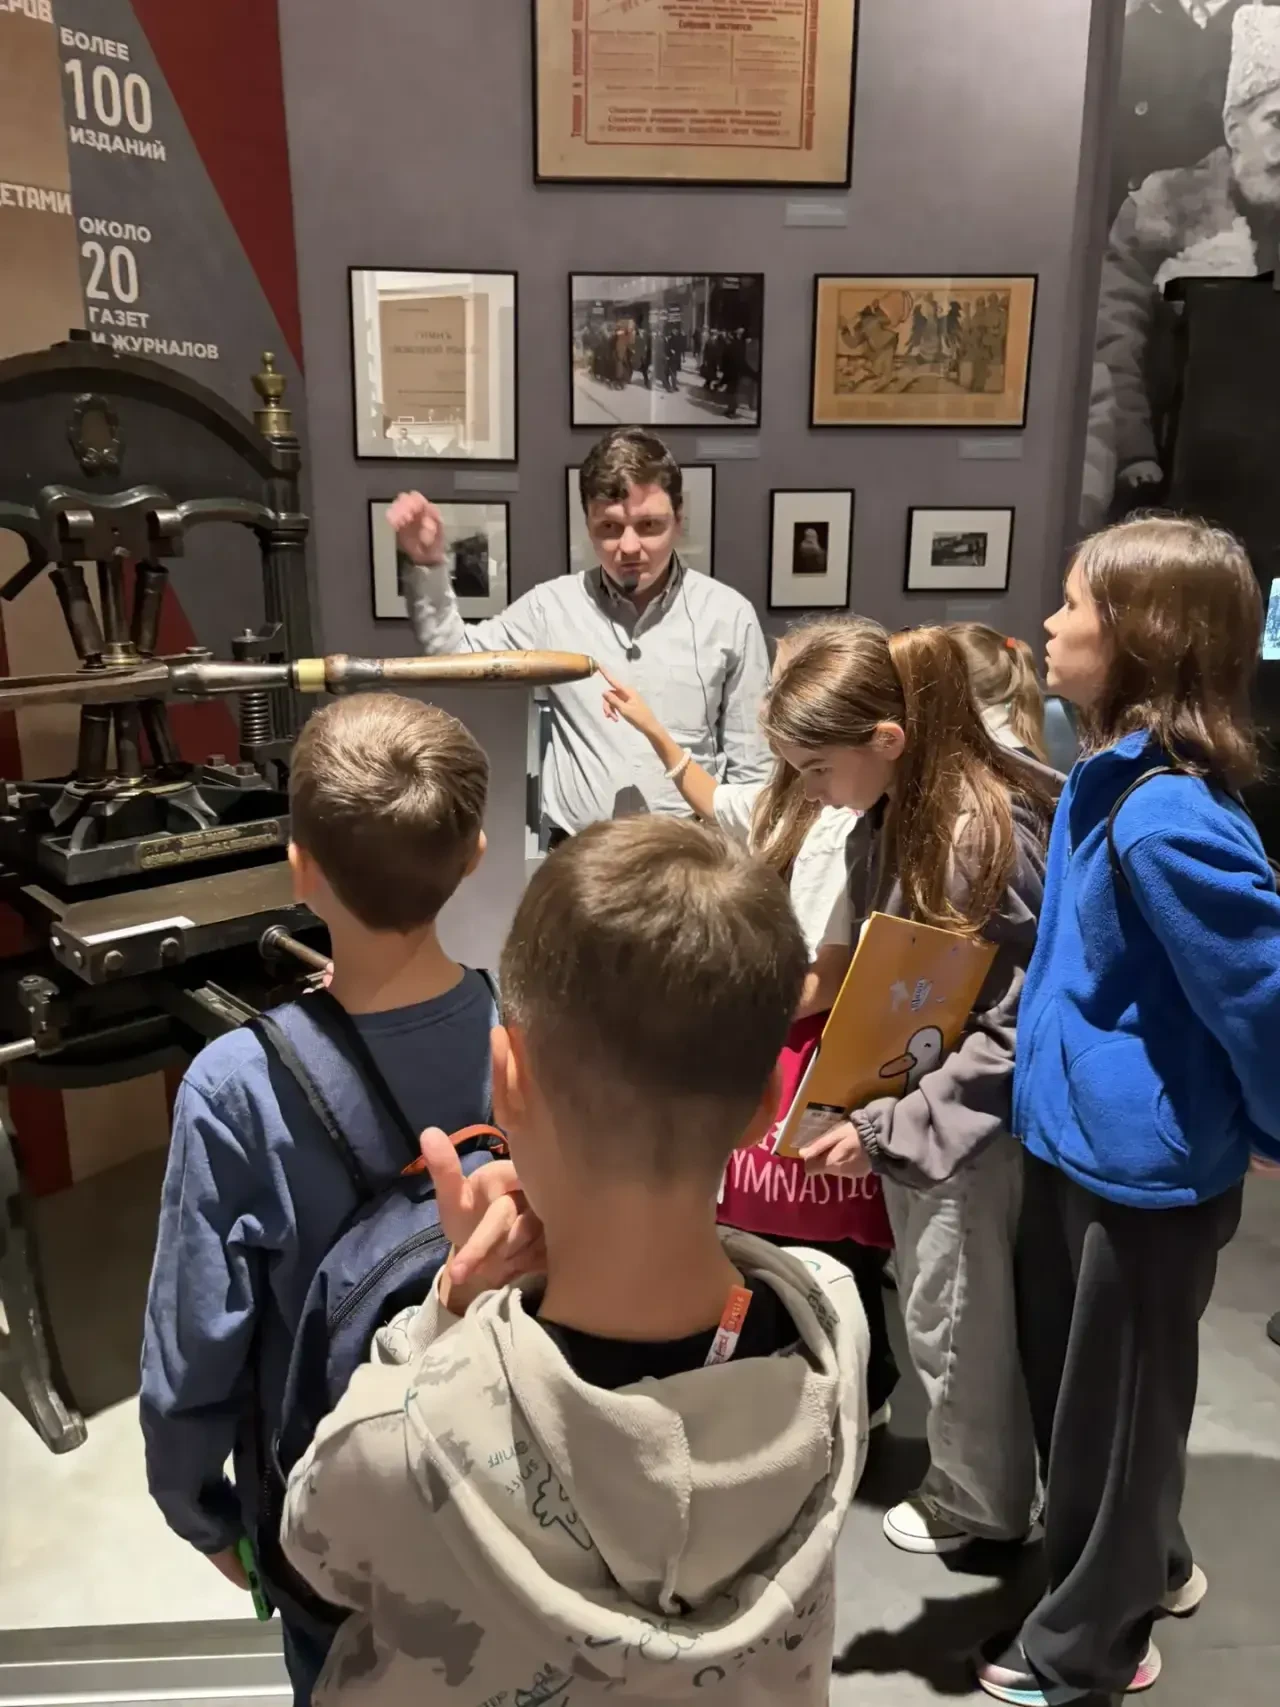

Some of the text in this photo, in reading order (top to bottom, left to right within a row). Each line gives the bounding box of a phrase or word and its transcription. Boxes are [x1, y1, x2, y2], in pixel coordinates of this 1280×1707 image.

[60, 26, 130, 62] БОЛЕЕ
[64, 59, 153, 134] 100
[69, 125, 167, 162] ИЗДАНИЙ
[0, 182, 73, 216] ЕТАМИ
[79, 216, 152, 243] ОКОЛО
[81, 241, 140, 304] 20
[88, 306, 149, 329] ГАЗЕТ
[111, 333, 219, 360] ЖУРНАЛОВ
[716, 1149, 877, 1205] YMNASTIC
